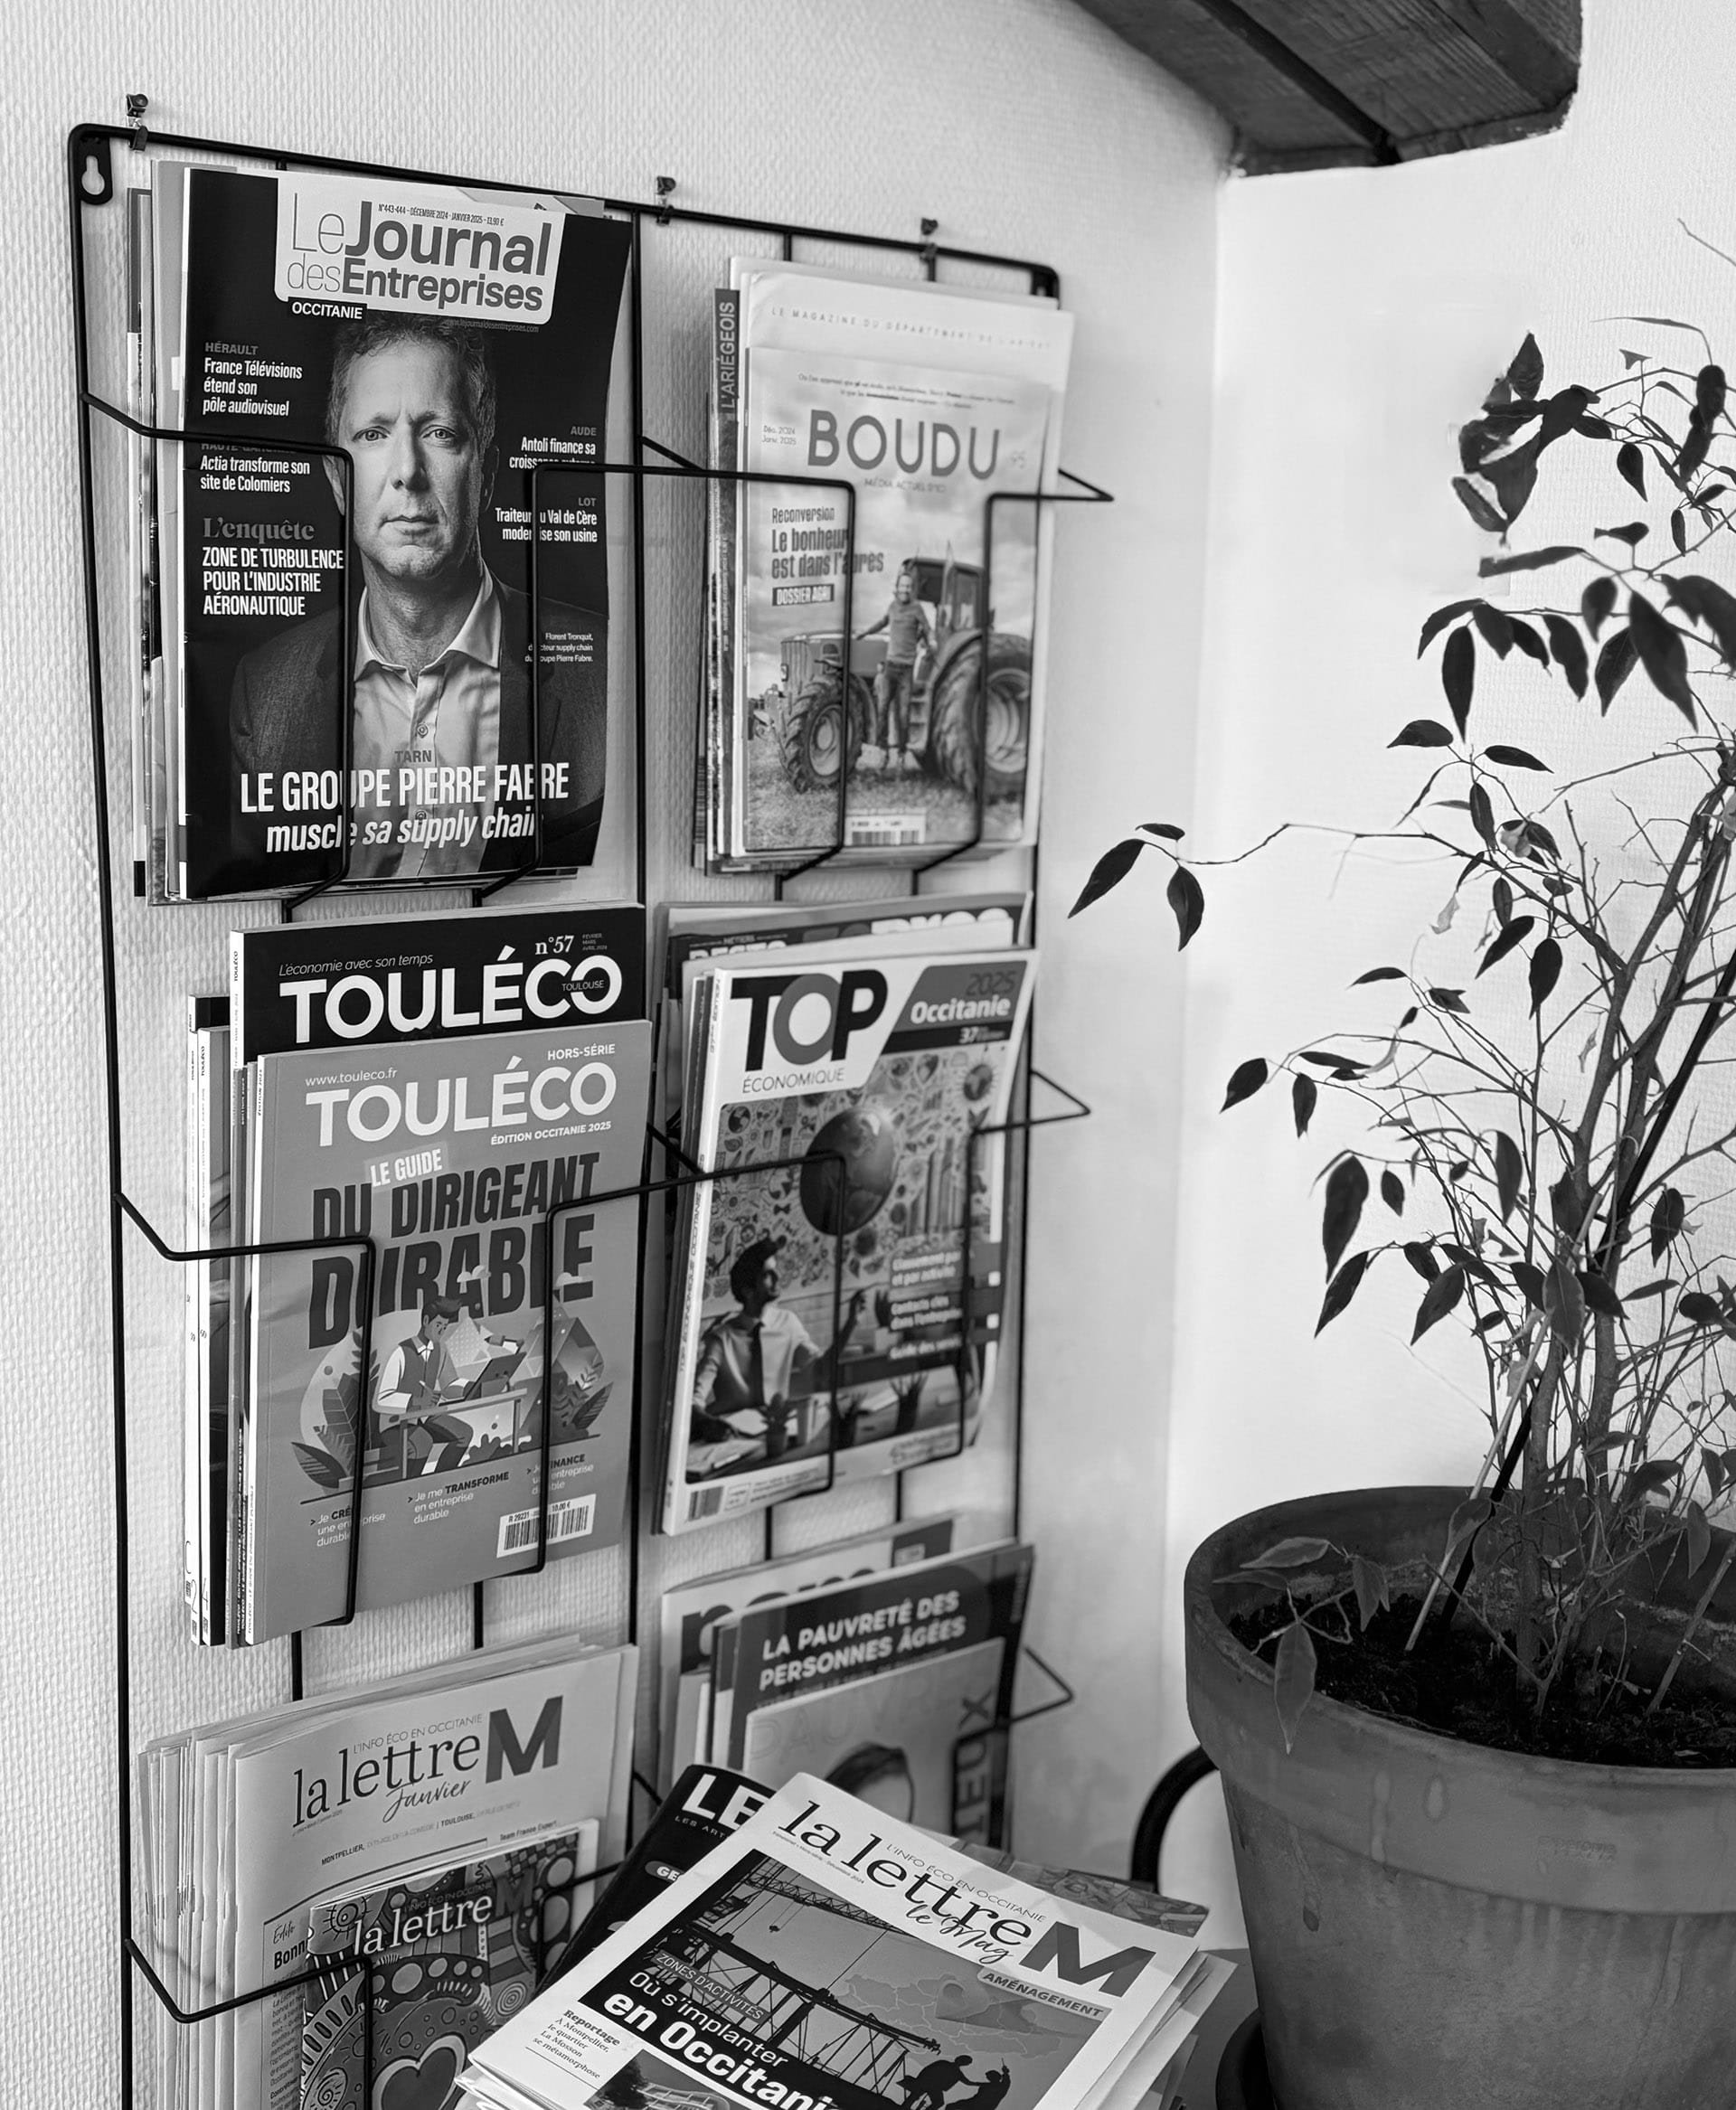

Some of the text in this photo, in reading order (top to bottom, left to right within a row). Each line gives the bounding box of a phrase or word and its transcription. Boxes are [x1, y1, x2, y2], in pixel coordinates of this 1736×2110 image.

[293, 193, 552, 276] Le Journal
[288, 253, 543, 311] des Entreprises
[292, 301, 363, 319] OCCITANIE
[204, 341, 259, 356] HÉRAULT
[716, 302, 735, 410] L'ARIÉGEOIS
[204, 357, 303, 379] France Télévisions
[203, 377, 258, 396] étend son
[203, 397, 289, 417] pôle audiovisuel
[570, 426, 597, 437] AUDE
[807, 409, 1000, 481] BOUDU
[521, 437, 597, 456] Antoli finance sa
[200, 455, 310, 476] Actia transforme son
[201, 474, 291, 493] site de Colomiers
[547, 509, 562, 524] Val
[563, 510, 575, 524] de
[576, 505, 597, 526] Cère
[578, 498, 597, 508] LOT
[771, 505, 835, 524] Reconversion
[203, 516, 316, 544] L'enquête
[503, 526, 597, 542] moderise son usine
[771, 527, 849, 553] Le bonheur
[203, 546, 344, 570] ZONE DE TURBULENCE
[771, 552, 830, 579] est dans
[203, 570, 321, 593] POUR L'INDUSTRIE
[203, 591, 307, 617] AÉRONAUTIQUE
[777, 586, 812, 606] DOSSIER
[545, 632, 567, 641] Florent
[556, 643, 594, 654] supply chain
[395, 749, 432, 763] TARN
[241, 772, 274, 813] LE
[281, 768, 392, 811] GROUPE
[399, 765, 486, 805] PIERRE
[266, 809, 478, 852] muscle sa supply
[534, 934, 575, 956] n°57
[278, 952, 434, 977] L'économie avec son temps
[279, 945, 623, 1043] TOULÉCO
[561, 979, 605, 992] TOULOUSE
[965, 970, 1017, 996] 2025
[731, 968, 889, 1072] TOP
[910, 994, 1011, 1024] Occitanie
[547, 1042, 616, 1061] HORS-SÉRIE
[305, 1066, 398, 1087] www.touleco.fr
[741, 1067, 846, 1094] ÉCONOMIQUE
[305, 1055, 617, 1146] TOULÉCO
[490, 1120, 612, 1146] ÉDITION OCCITANIE 2025
[370, 1147, 443, 1188] LE GUIDE
[313, 1152, 600, 1239] DU DIRIGEANT
[545, 1453, 586, 1469] INANCE
[415, 1471, 510, 1502] Je me TRANSFORME
[415, 1492, 475, 1513] en entreprise
[317, 1514, 329, 1524] Je
[317, 1524, 336, 1536] une
[413, 1509, 449, 1525] durable
[763, 1589, 960, 1662] LA PAUVRETÉ DES
[759, 1636, 892, 1691] PERSONNES
[897, 1615, 967, 1653] ÂGÉES
[353, 1713, 483, 1755] L'INFO ÉCO EN OCCITANIE
[292, 1695, 563, 1828] la lettre M
[382, 1779, 472, 1823] Janvier
[675, 1815, 698, 1827] LES
[320, 1813, 476, 1867] MONTPELLIER, TOULOUSE,
[886, 1842, 1049, 1923] L'INFO ÉCO EN OCCITANIE
[778, 1800, 1156, 1997] la lettre M
[354, 1895, 494, 1956] la lettre
[905, 1903, 1014, 1964] le Mag
[274, 1938, 308, 1970] Bonn
[656, 1953, 765, 2021] ZONES D'ACTIVITÉS
[982, 1970, 1105, 2019] AMÉNAGEMENT
[603, 1992, 658, 2033] en
[629, 1971, 789, 2069] Où s'implanter
[547, 2022, 590, 2051] le quartier
[562, 2009, 621, 2048] Reportage
[563, 2021, 610, 2054] Montpellier,
[540, 2030, 583, 2058] La Mosson
[533, 2037, 601, 2080] se métamorphose
